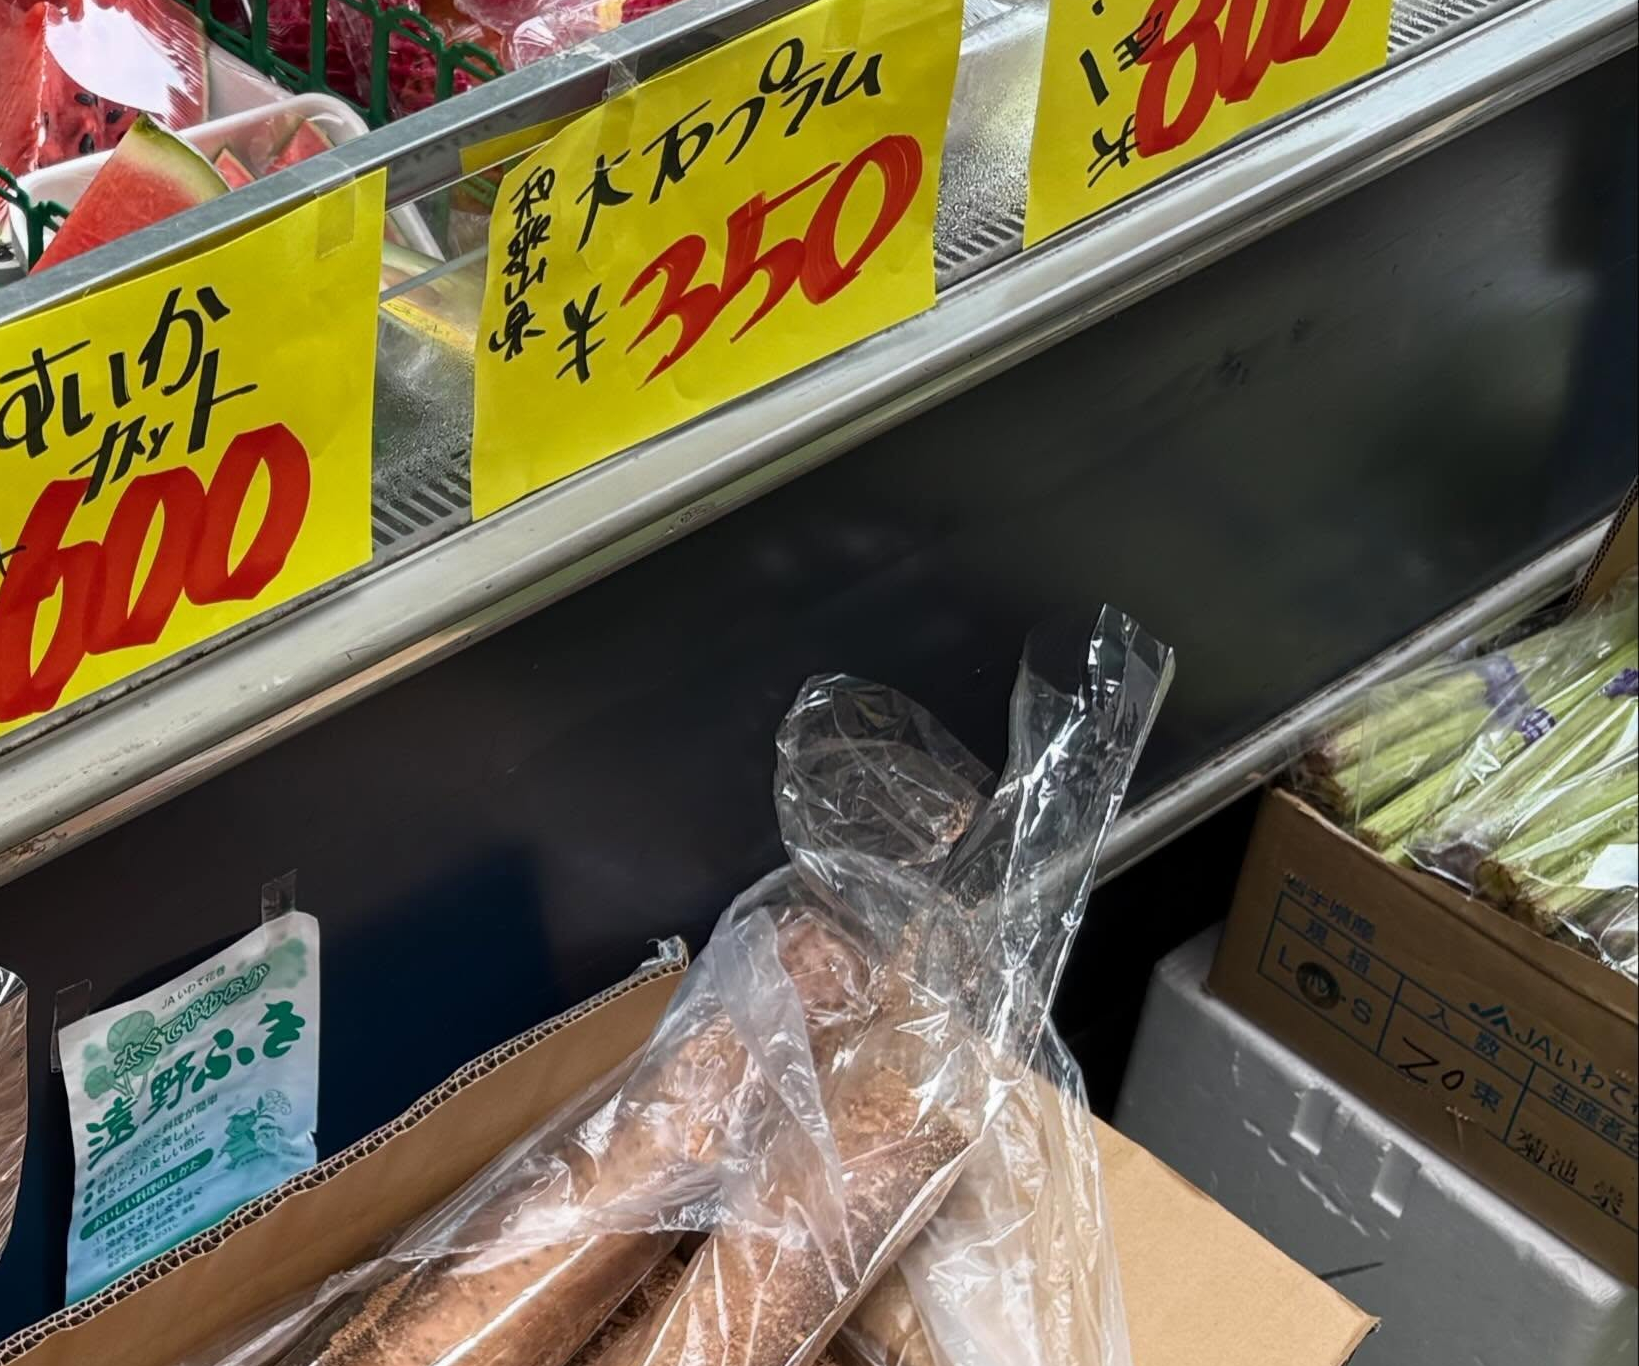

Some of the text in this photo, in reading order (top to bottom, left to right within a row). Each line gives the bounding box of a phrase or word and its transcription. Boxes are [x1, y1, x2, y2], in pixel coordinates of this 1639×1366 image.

[555, 134, 924, 391] ¥350
[86, 1000, 305, 1171] 遠野ふき
